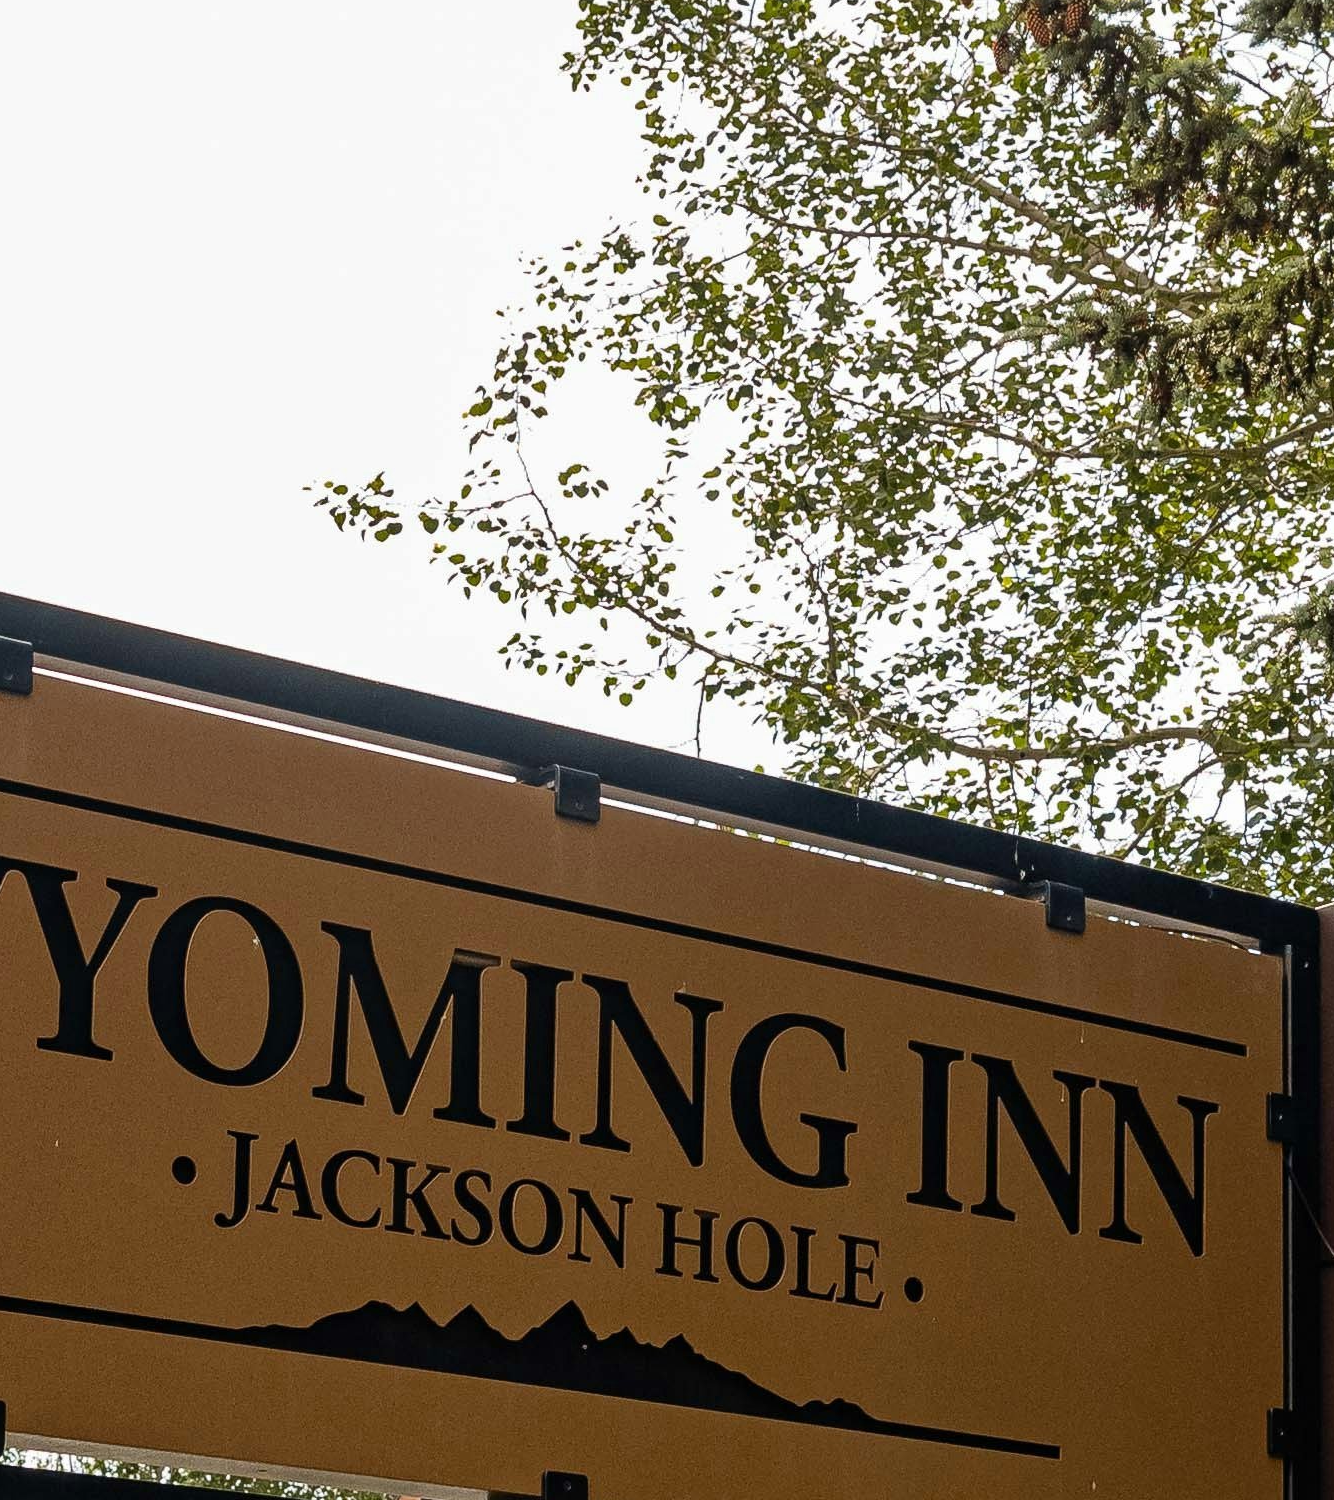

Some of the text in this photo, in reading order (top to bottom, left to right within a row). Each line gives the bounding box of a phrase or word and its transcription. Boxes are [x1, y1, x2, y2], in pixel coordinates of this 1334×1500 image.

[214, 1130, 885, 1311] JACKSON HOLE
[906, 1039, 1220, 1260] INN
